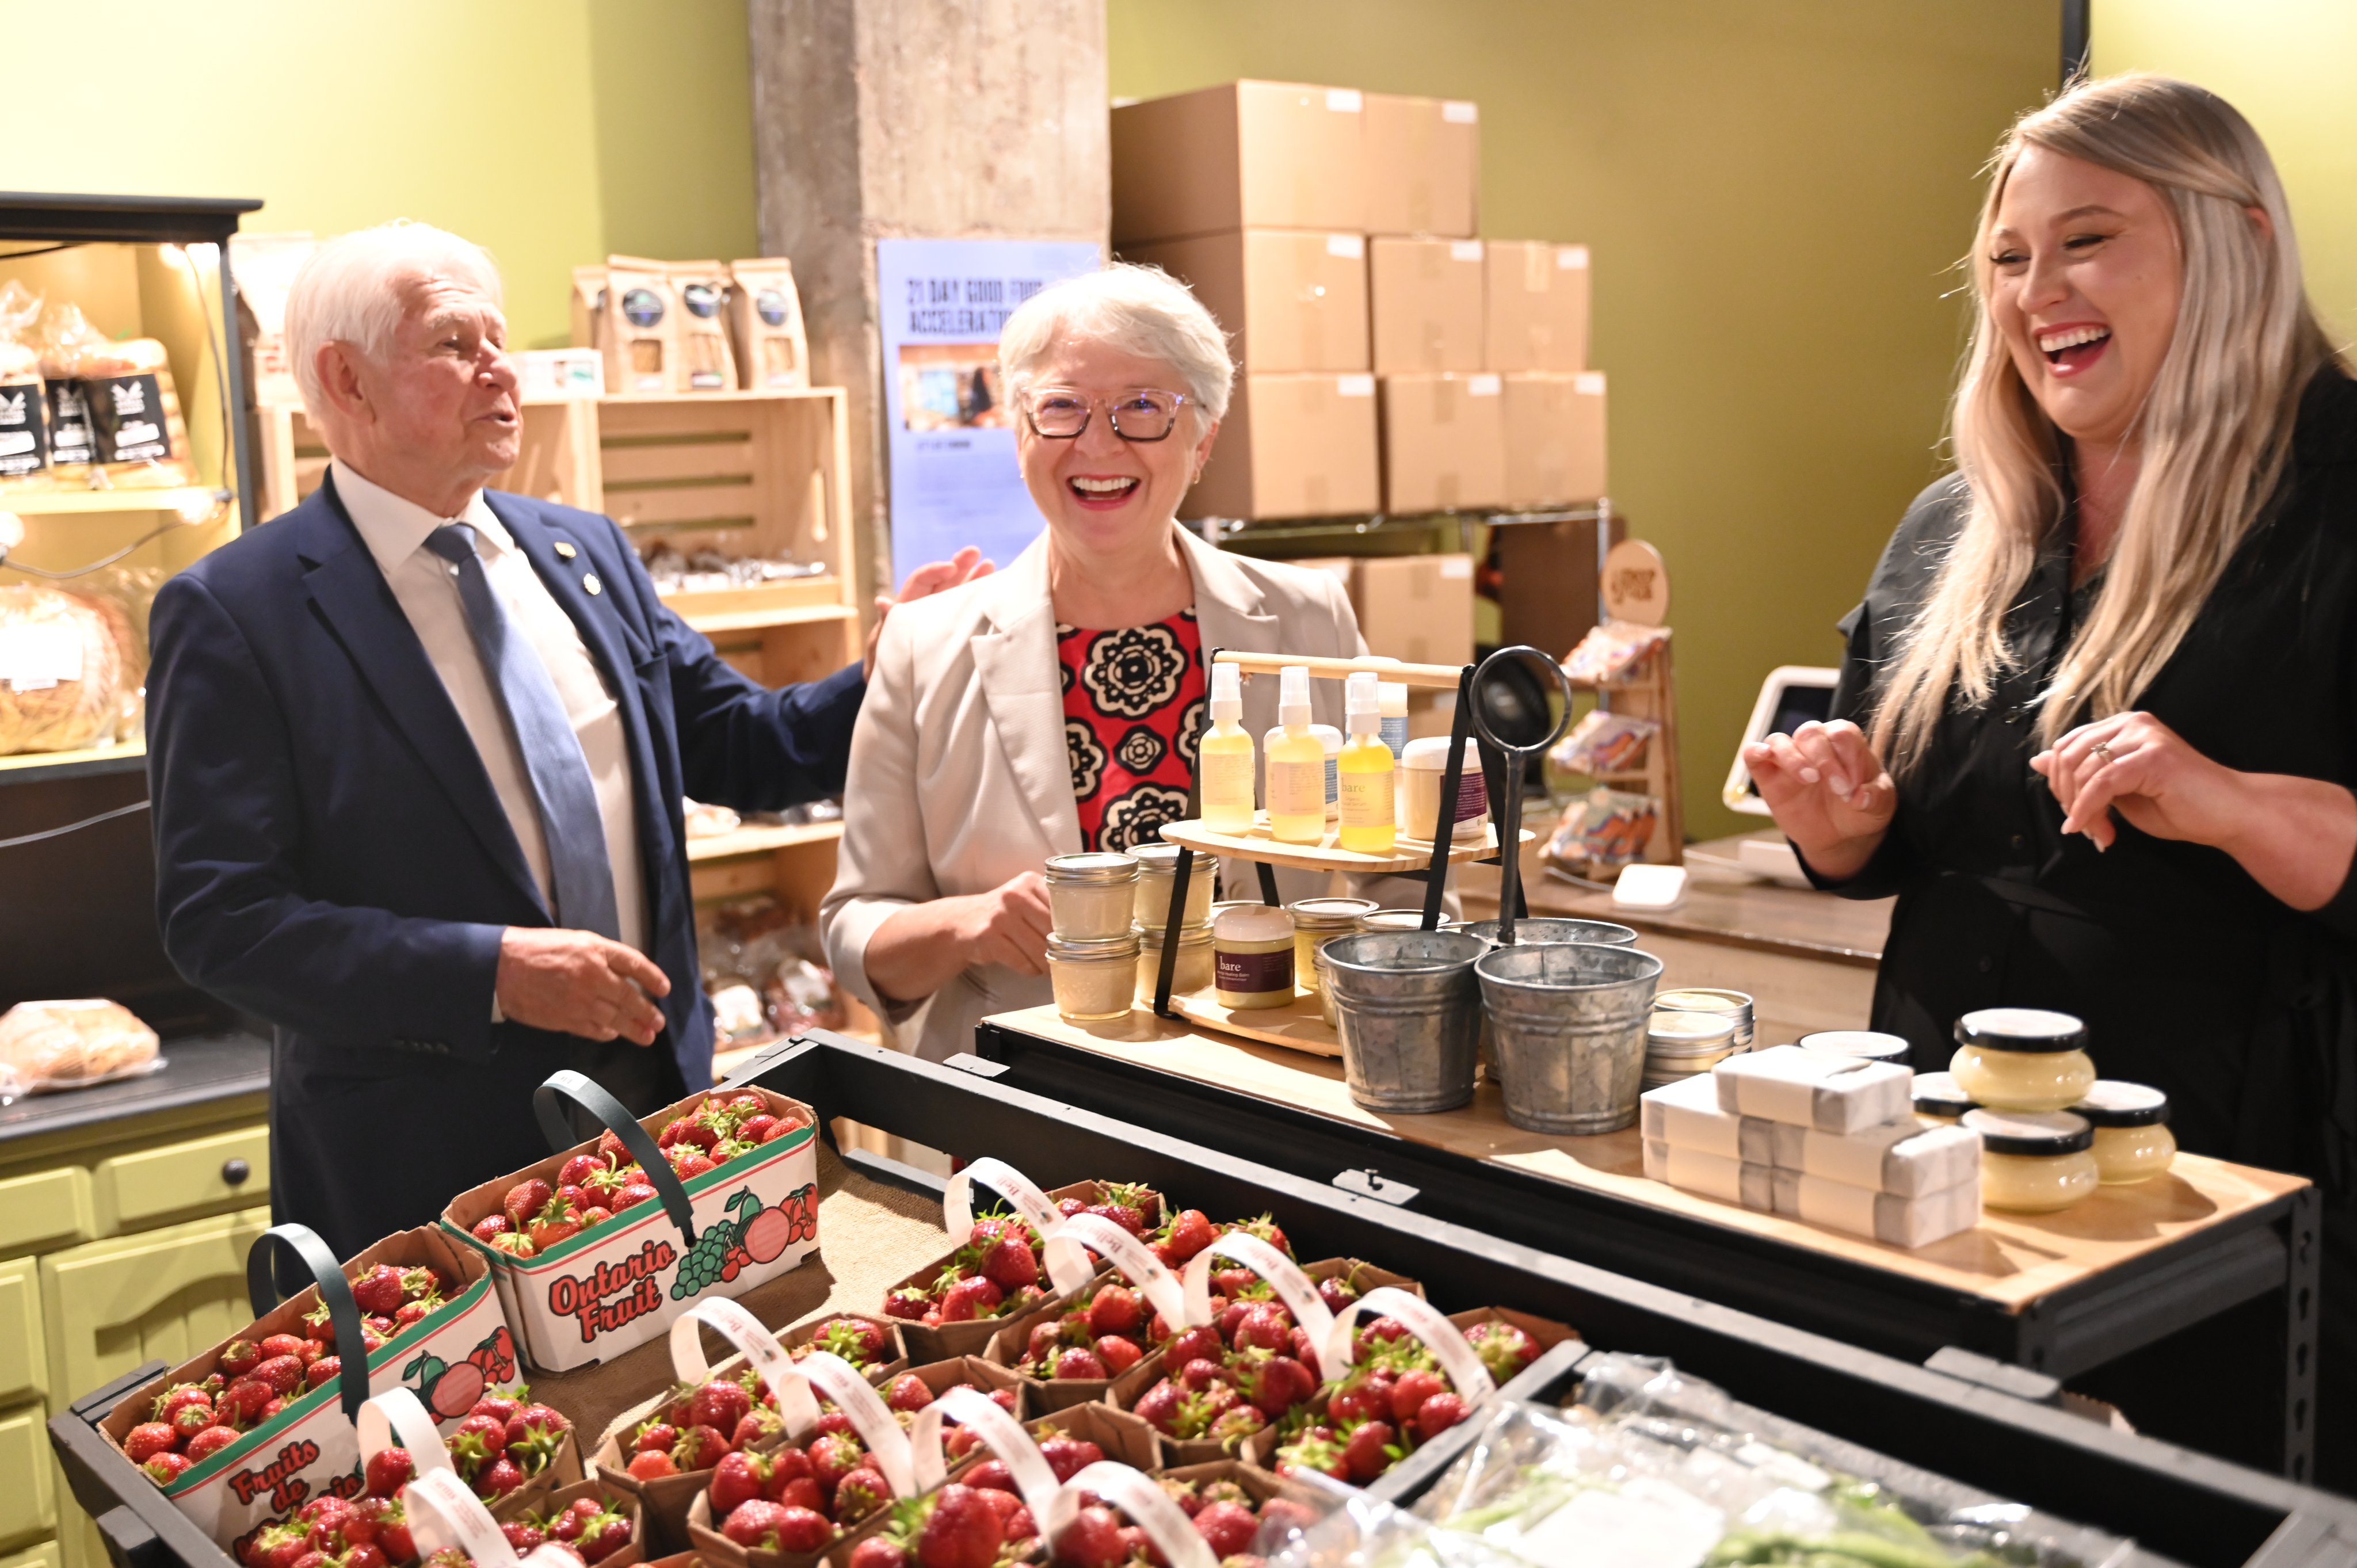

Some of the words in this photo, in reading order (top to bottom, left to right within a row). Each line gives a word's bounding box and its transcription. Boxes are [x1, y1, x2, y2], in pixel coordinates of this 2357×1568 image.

[930, 280, 959, 303] DAY
[967, 280, 1002, 303] GOOD
[1010, 280, 1043, 302] FOO
[1341, 777, 1366, 792] bare
[1219, 955, 1241, 972] bare
[549, 1240, 677, 1317] Ontario
[575, 1275, 663, 1343] Fruit
[228, 1439, 320, 1505] Fruits
[271, 1478, 311, 1514] de
